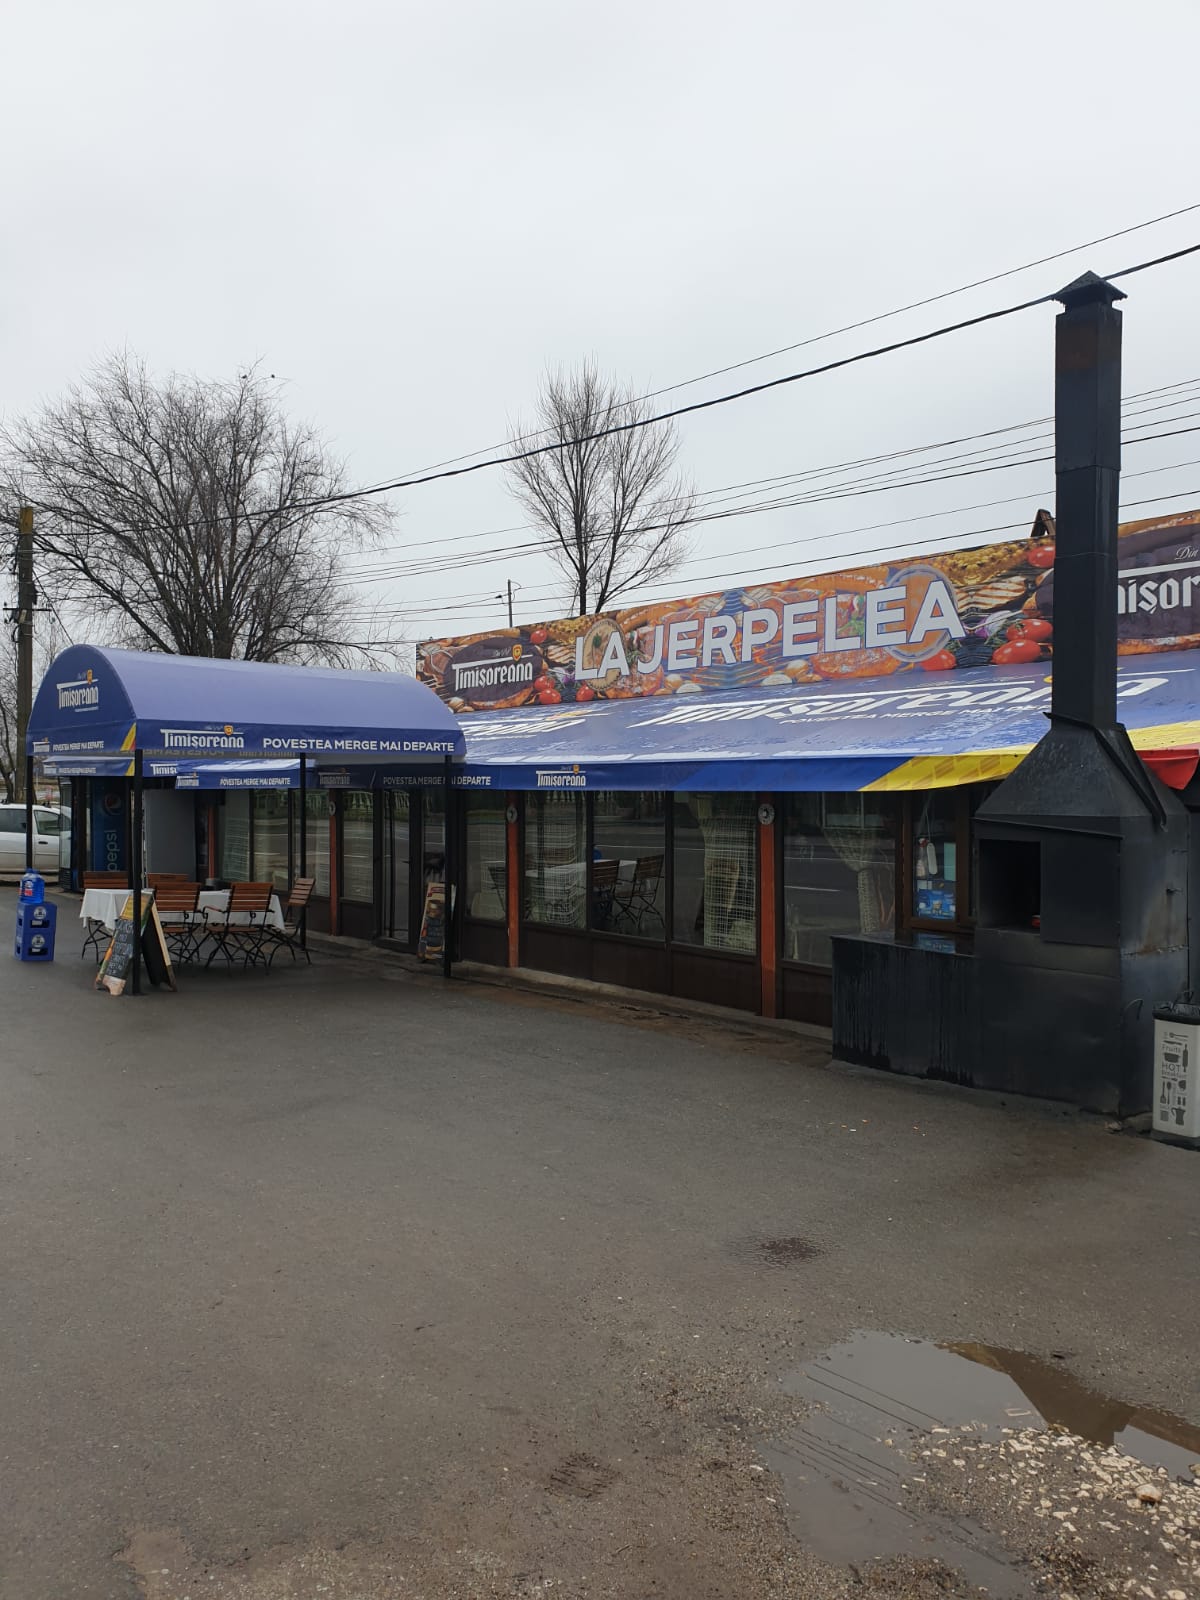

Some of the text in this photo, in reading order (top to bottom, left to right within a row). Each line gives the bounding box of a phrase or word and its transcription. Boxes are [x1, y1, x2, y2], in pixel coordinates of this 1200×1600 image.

[575, 580, 966, 680] LA JERPELEA
[452, 654, 534, 691] Timișoreana
[160, 728, 244, 748] Timișoreana
[263, 738, 455, 751] POVESTEA MERGE MAI DEPARTE
[383, 776, 417, 785] POVESTEA
[417, 776, 443, 785] MERGE
[456, 776, 491, 785] DEPARTE
